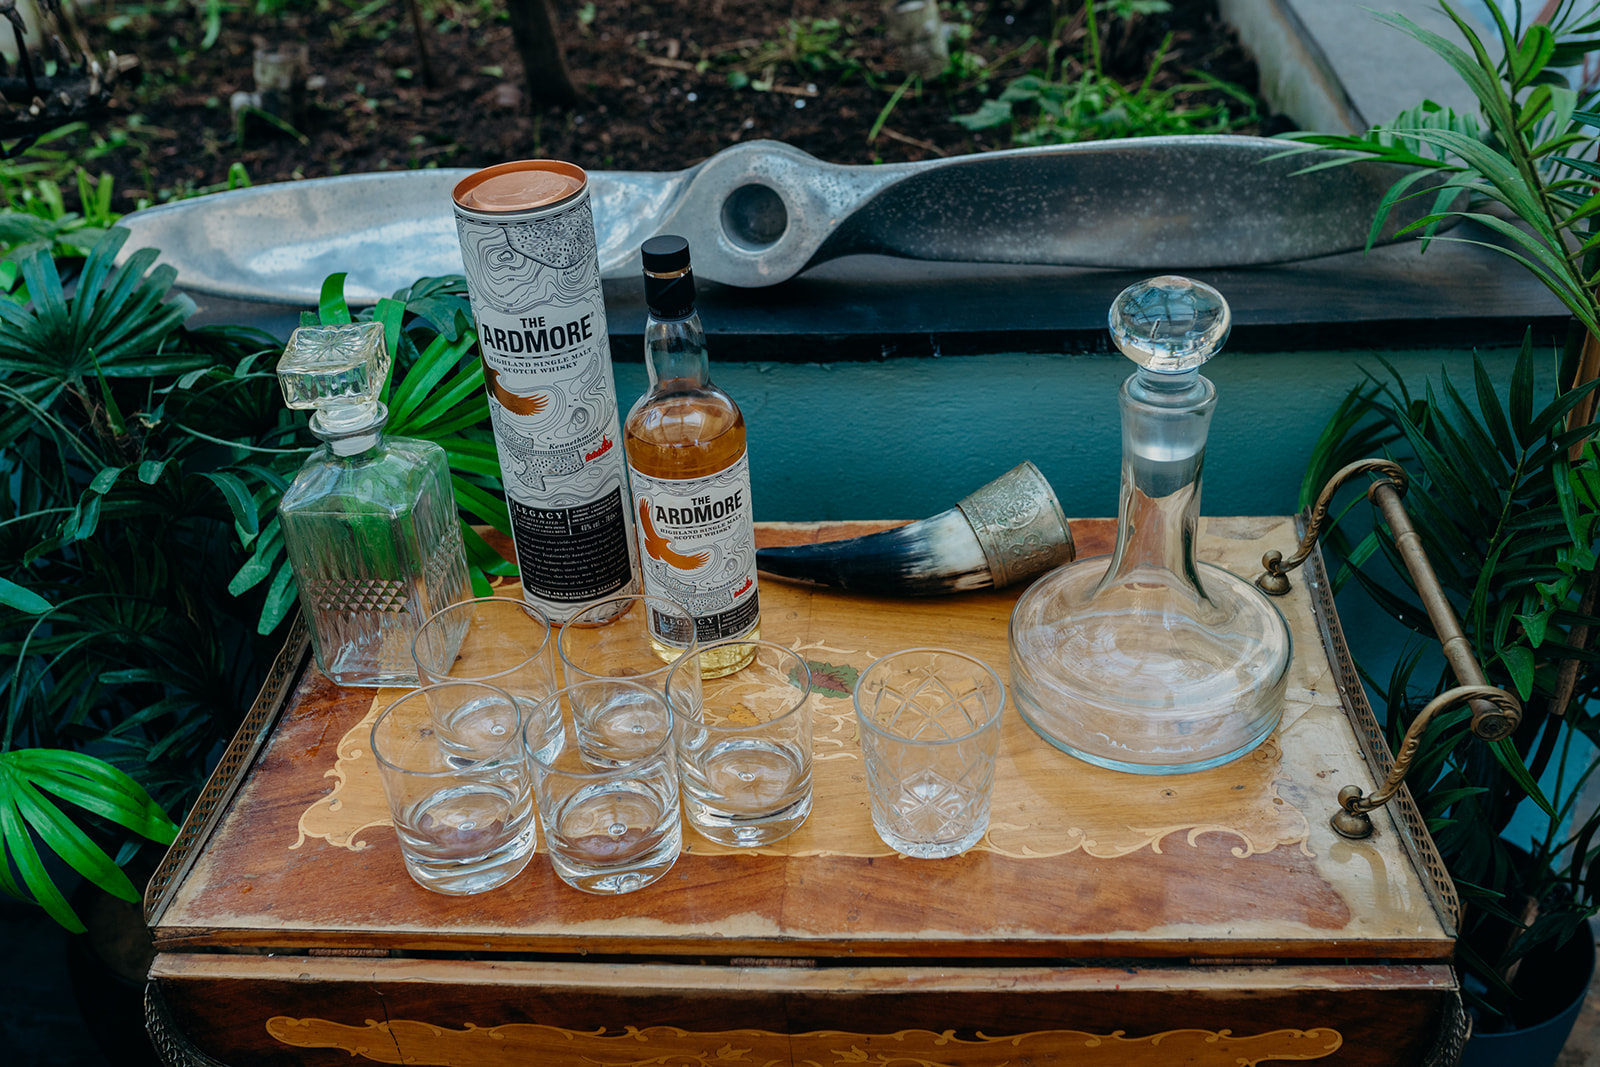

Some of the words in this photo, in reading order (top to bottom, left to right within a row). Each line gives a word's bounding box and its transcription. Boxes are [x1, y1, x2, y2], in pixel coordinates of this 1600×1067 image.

[520, 316, 546, 328] THE
[482, 313, 593, 353] ARDMORE
[489, 355, 531, 368] HIGHLAND
[533, 356, 569, 367] SINGLE
[571, 347, 592, 360] MALT
[503, 366, 537, 374] SCOTCH
[540, 361, 578, 374] WHISKY
[549, 426, 600, 450] Kennethmont
[655, 488, 743, 525] ARDMORE
[691, 495, 711, 506] THE
[515, 504, 563, 519] LEGACY
[660, 528, 698, 536] HIGHLAND
[699, 523, 725, 533] SINGLE
[727, 513, 742, 524] MALT
[704, 525, 732, 537] WHISKY
